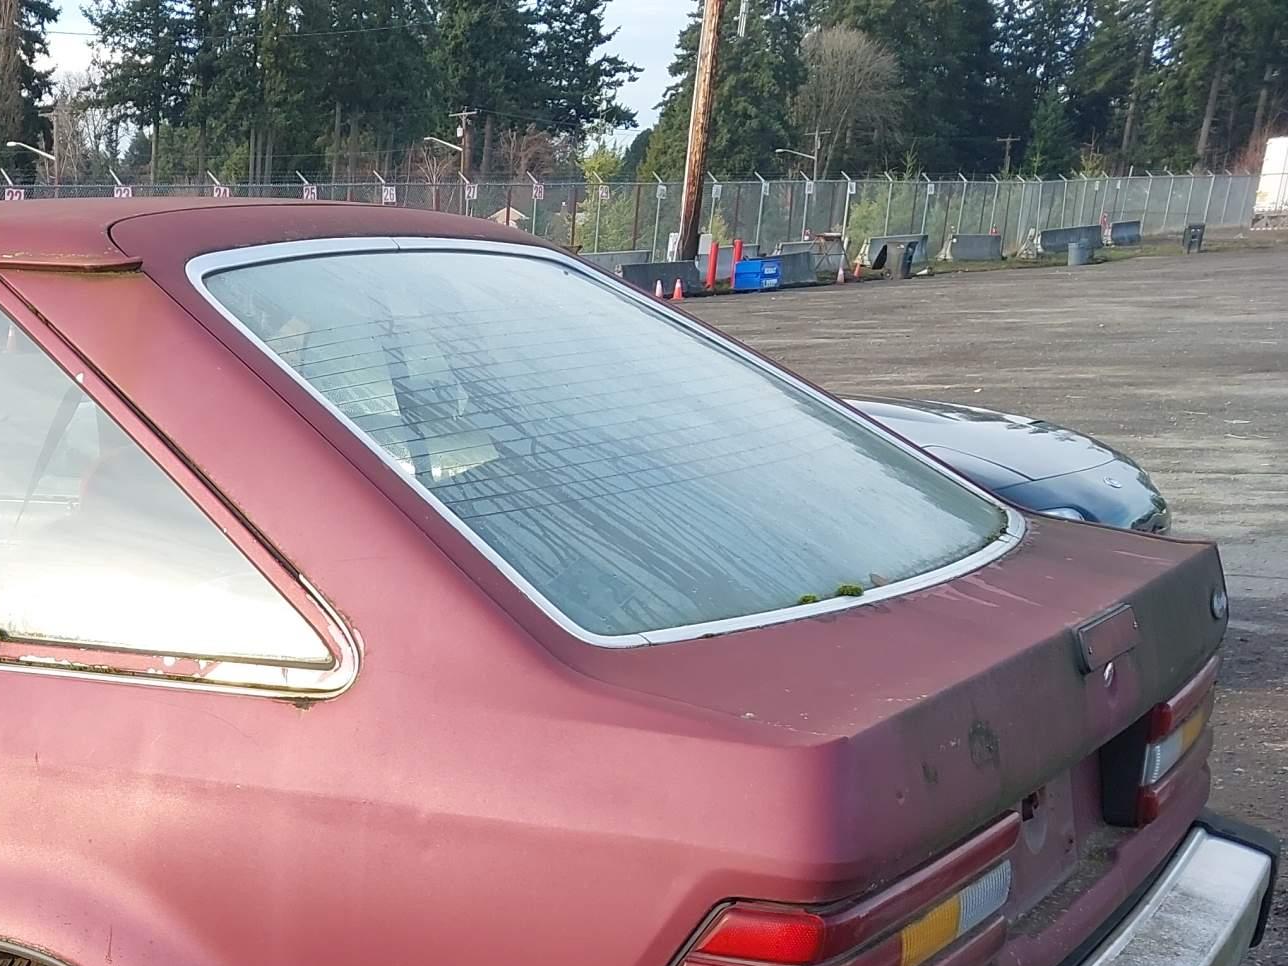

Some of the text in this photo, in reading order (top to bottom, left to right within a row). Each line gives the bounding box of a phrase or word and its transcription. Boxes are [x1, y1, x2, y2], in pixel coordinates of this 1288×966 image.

[383, 187, 395, 201] 26
[466, 185, 476, 199] 27
[534, 185, 543, 199] 28
